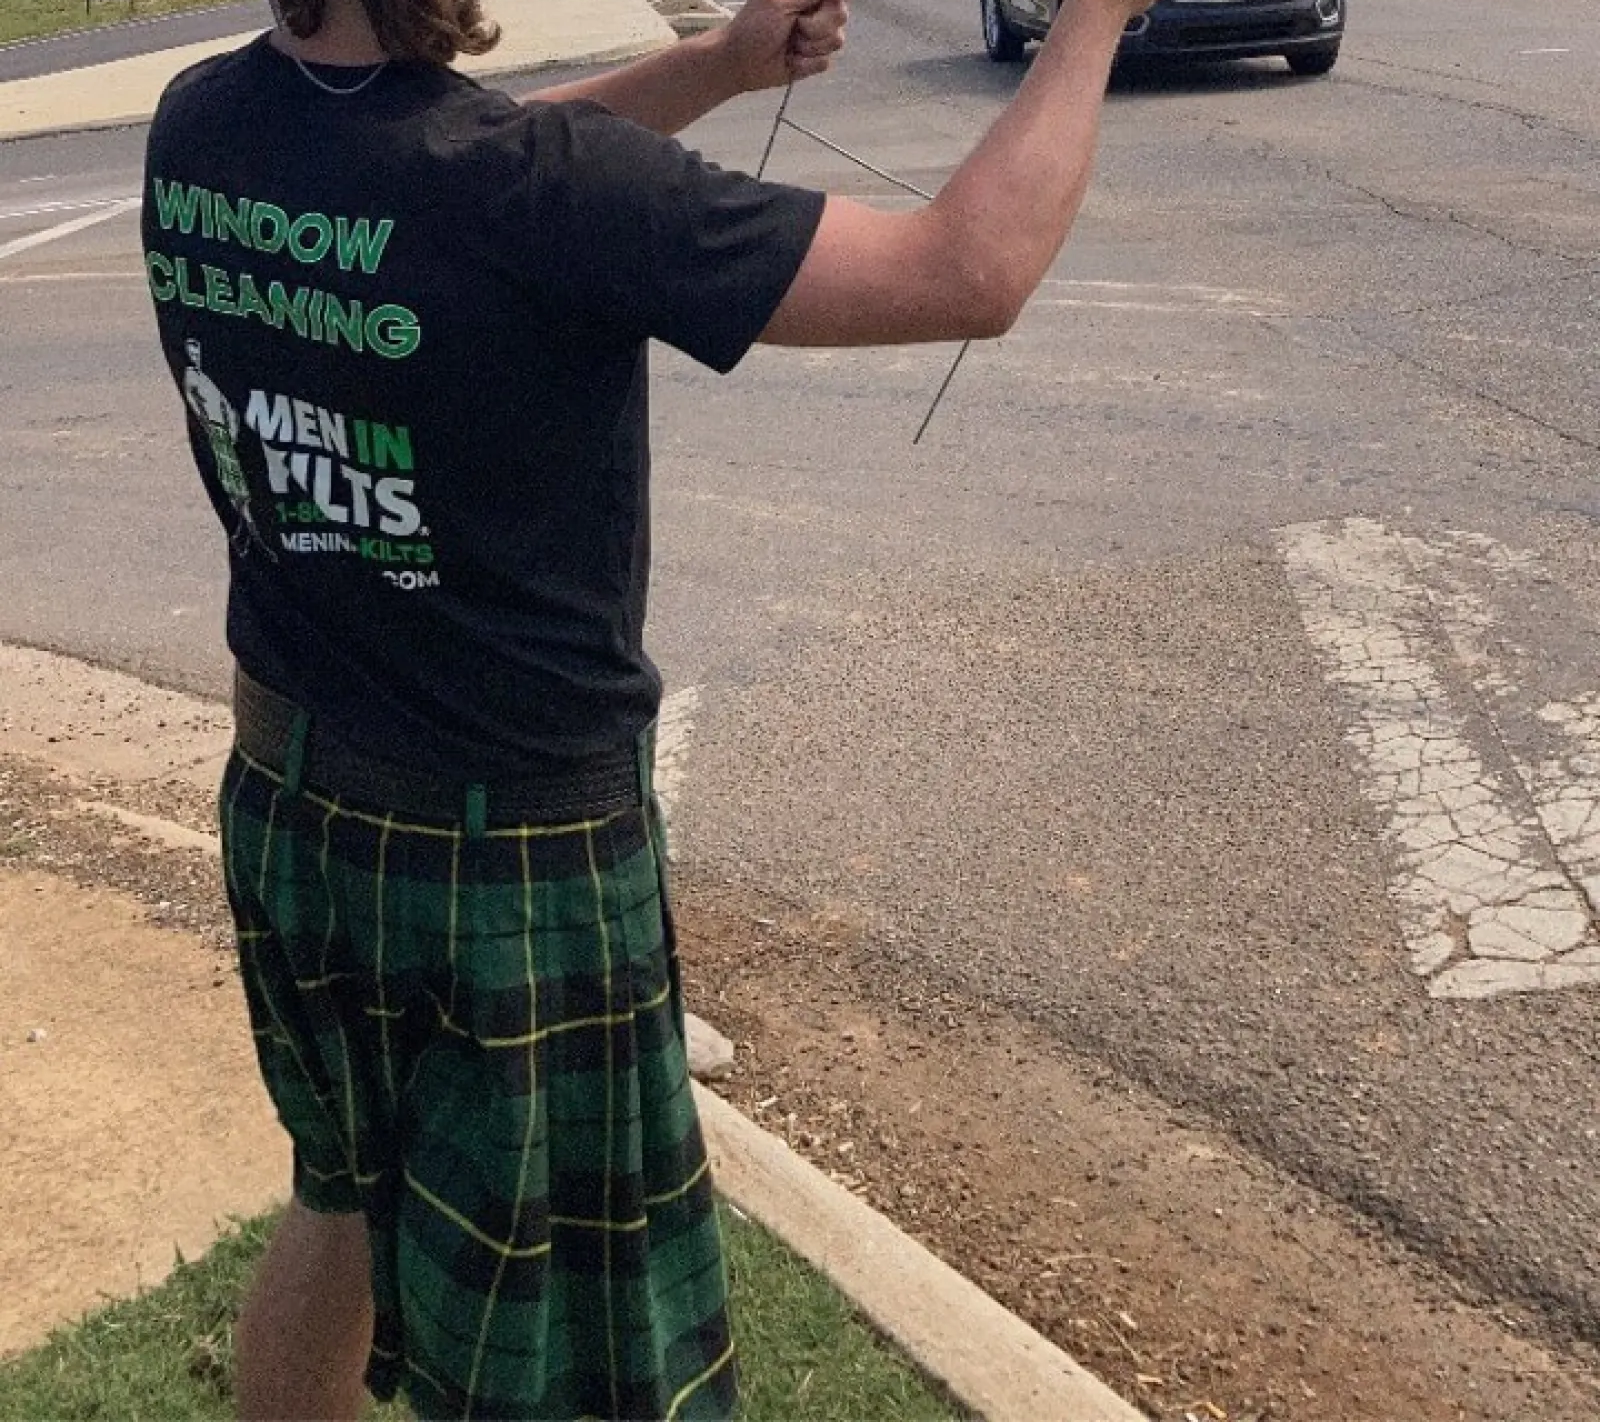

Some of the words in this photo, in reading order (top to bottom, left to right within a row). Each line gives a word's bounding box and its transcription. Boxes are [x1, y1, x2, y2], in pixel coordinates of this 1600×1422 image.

[154, 177, 396, 275] WINDOW
[144, 250, 421, 359] CLEANING
[246, 389, 350, 459] MEN
[353, 419, 414, 471] IN
